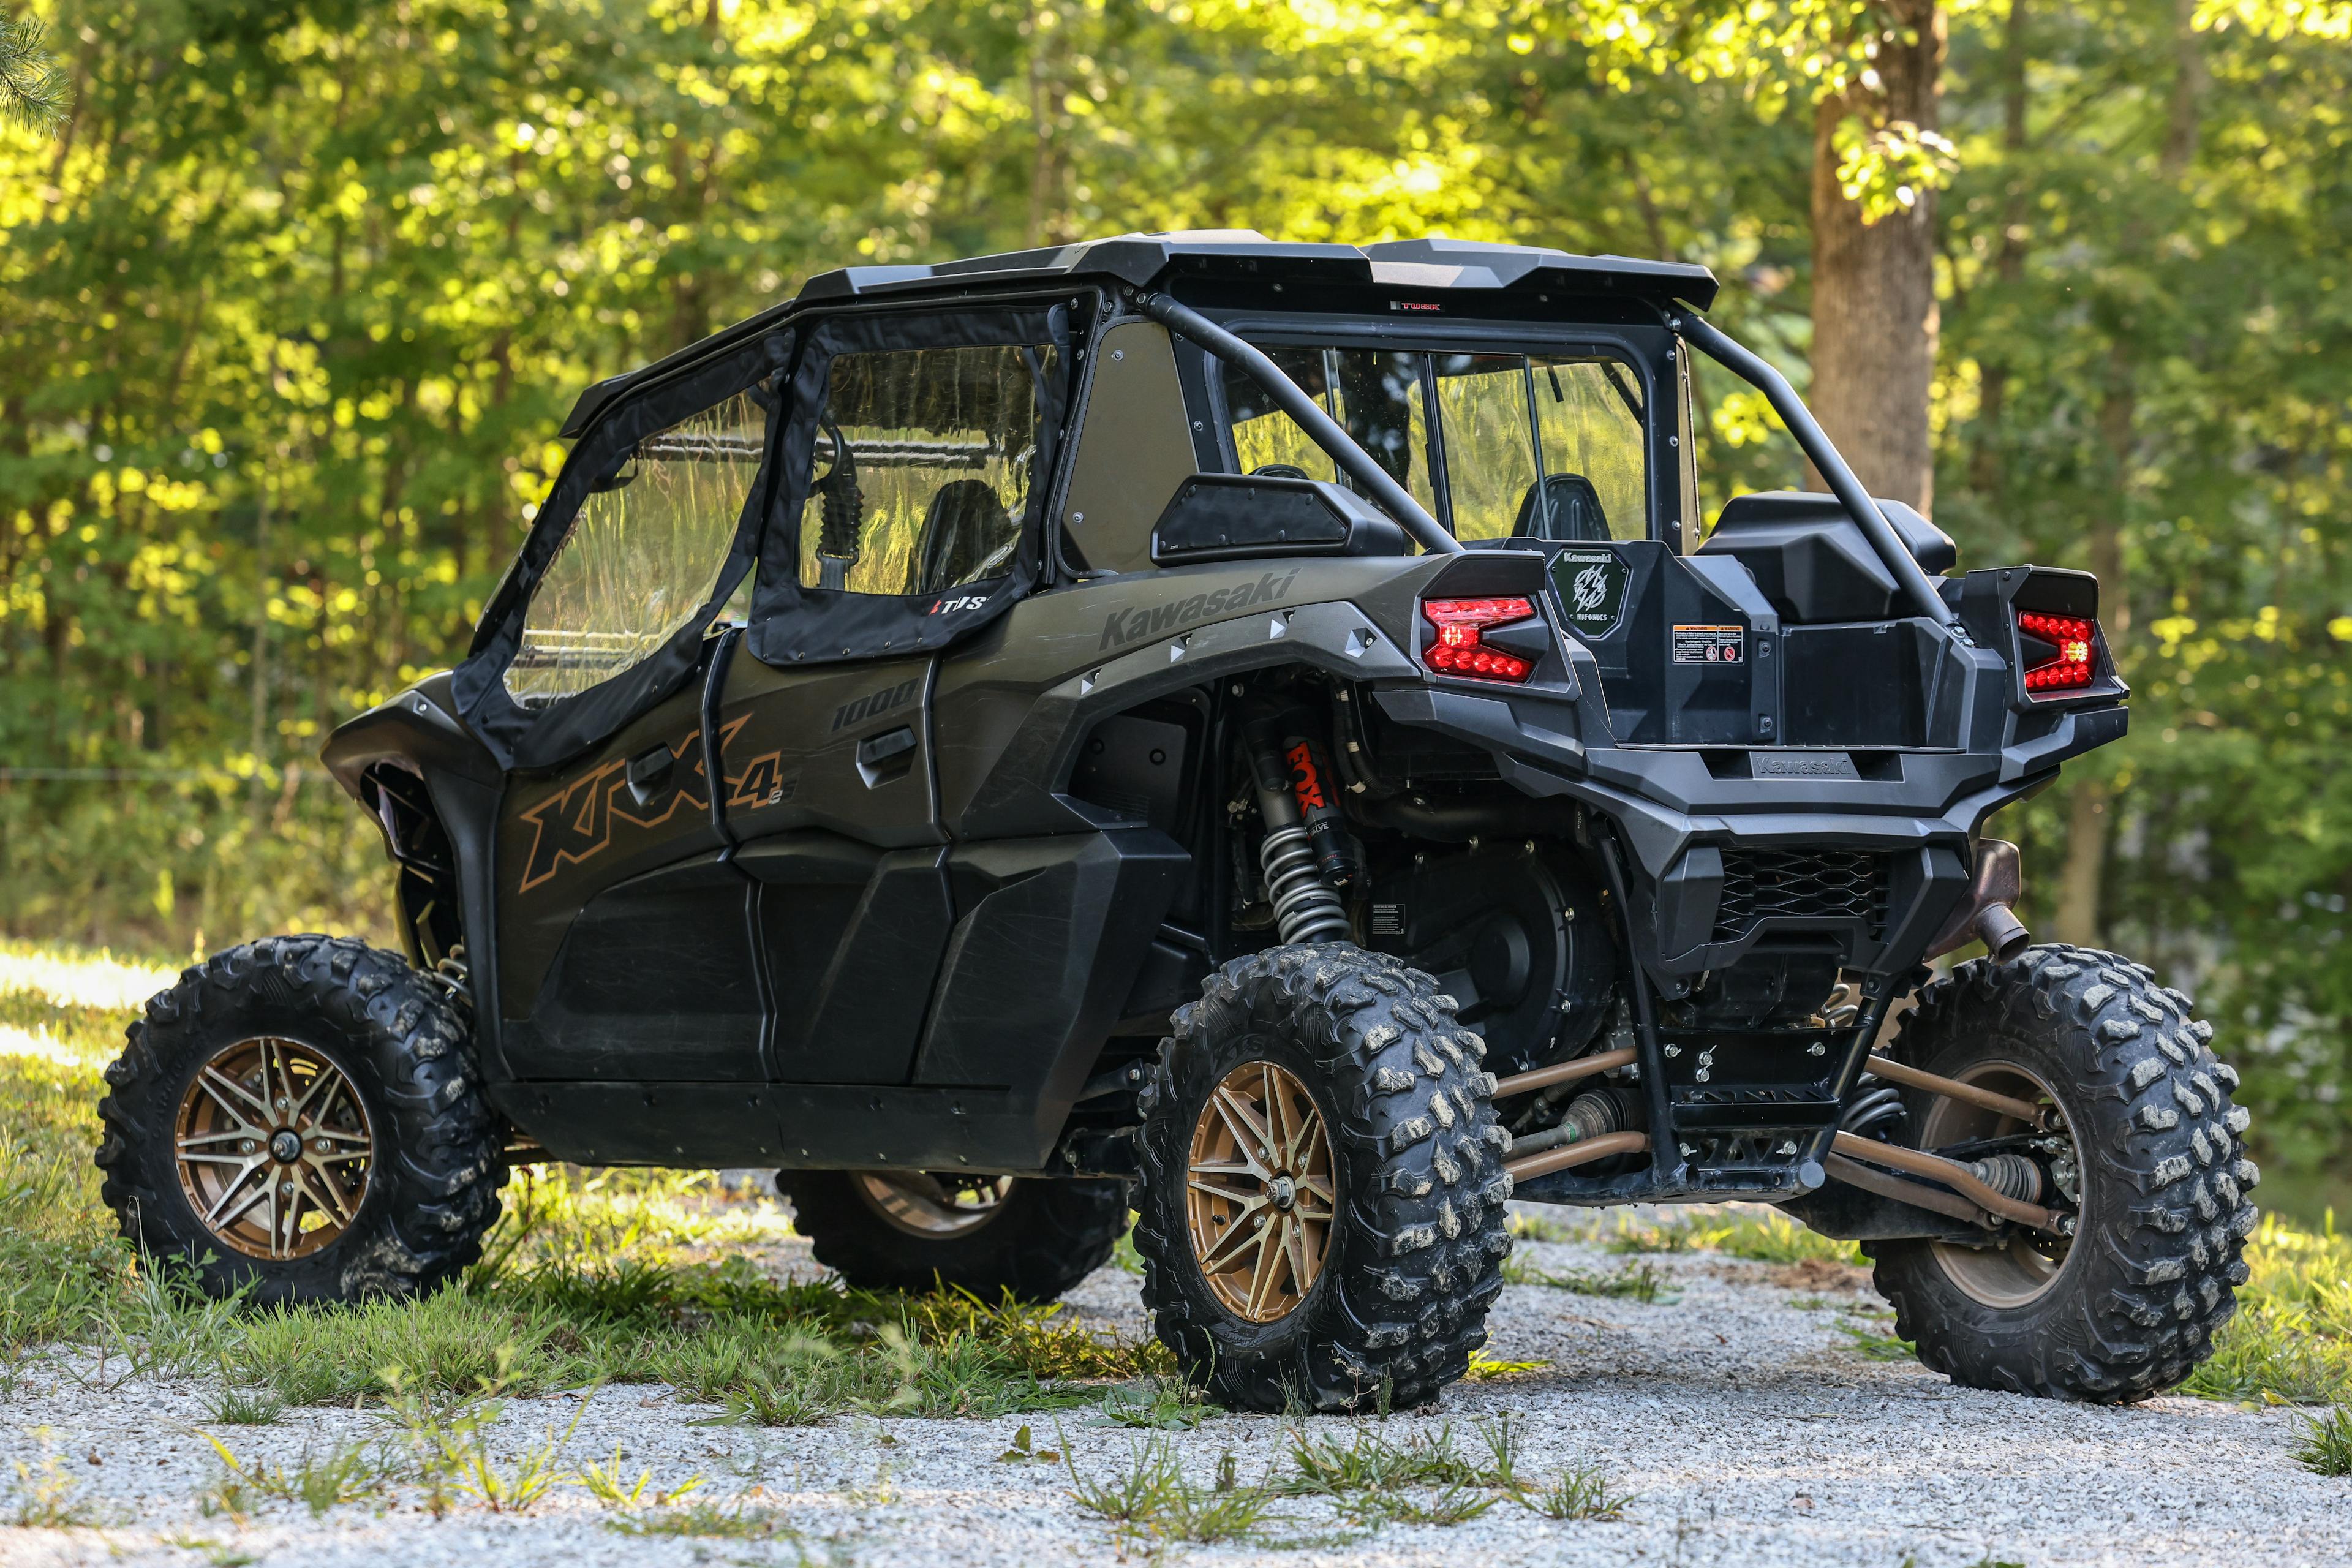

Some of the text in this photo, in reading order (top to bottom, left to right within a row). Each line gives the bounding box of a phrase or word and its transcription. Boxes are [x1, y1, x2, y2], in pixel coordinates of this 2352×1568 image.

[1564, 552, 1612, 564] Kawasaki
[1098, 567, 1303, 652] Kawasaki
[1577, 613, 1608, 622] HIFONICS
[832, 677, 919, 732] 1000
[1287, 741, 1326, 819] FOX
[1756, 757, 1851, 775] Kawasaki
